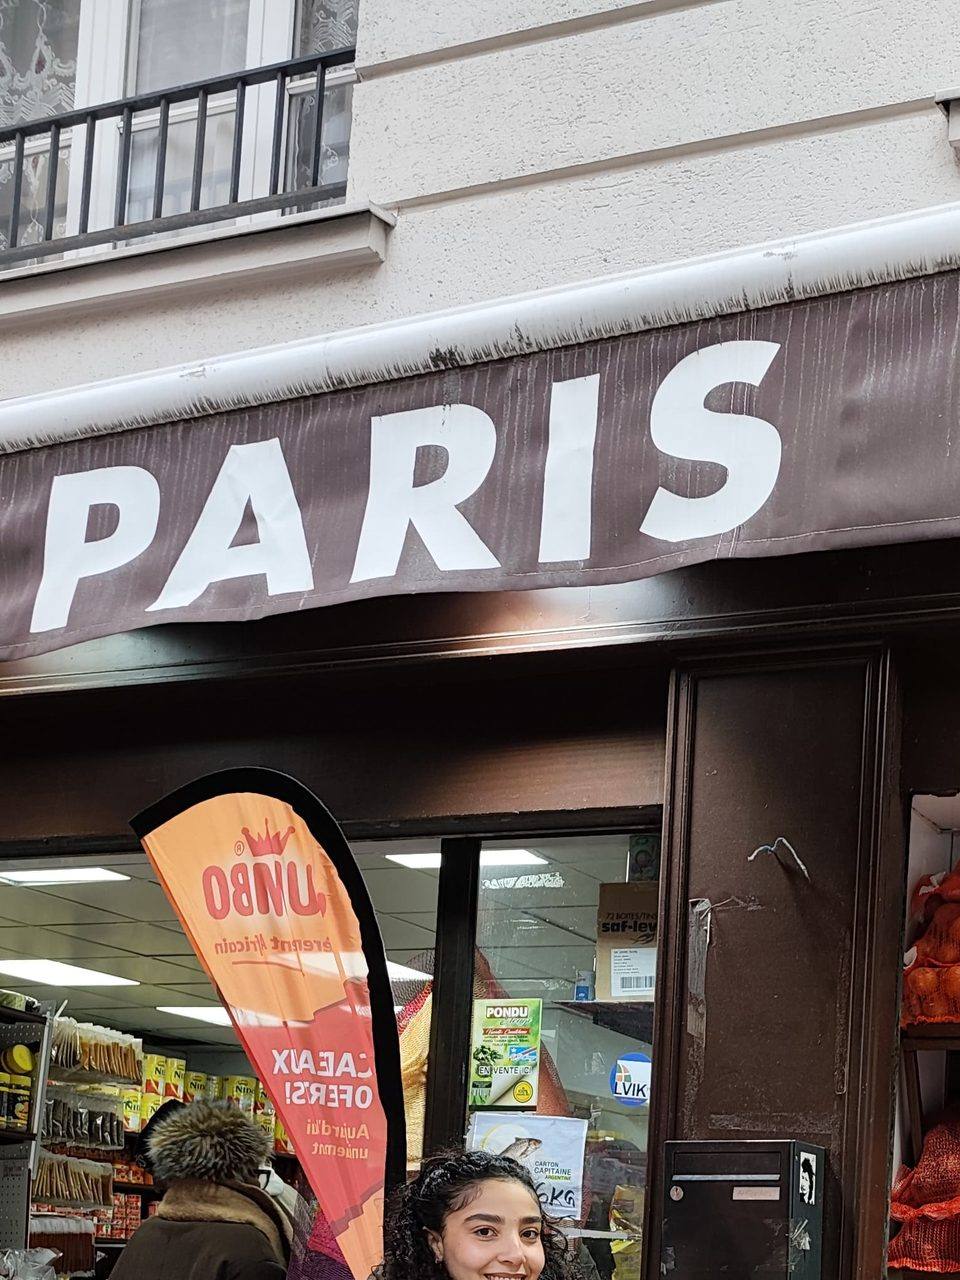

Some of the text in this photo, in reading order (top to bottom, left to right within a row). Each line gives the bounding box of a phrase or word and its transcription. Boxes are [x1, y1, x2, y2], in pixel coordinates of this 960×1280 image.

[30, 340, 782, 633] PARIS
[486, 1007, 528, 1018] PONDU
[479, 1066, 491, 1075] EN
[493, 1066, 519, 1075] VENTE
[534, 1167, 572, 1175] CAPITAINE
